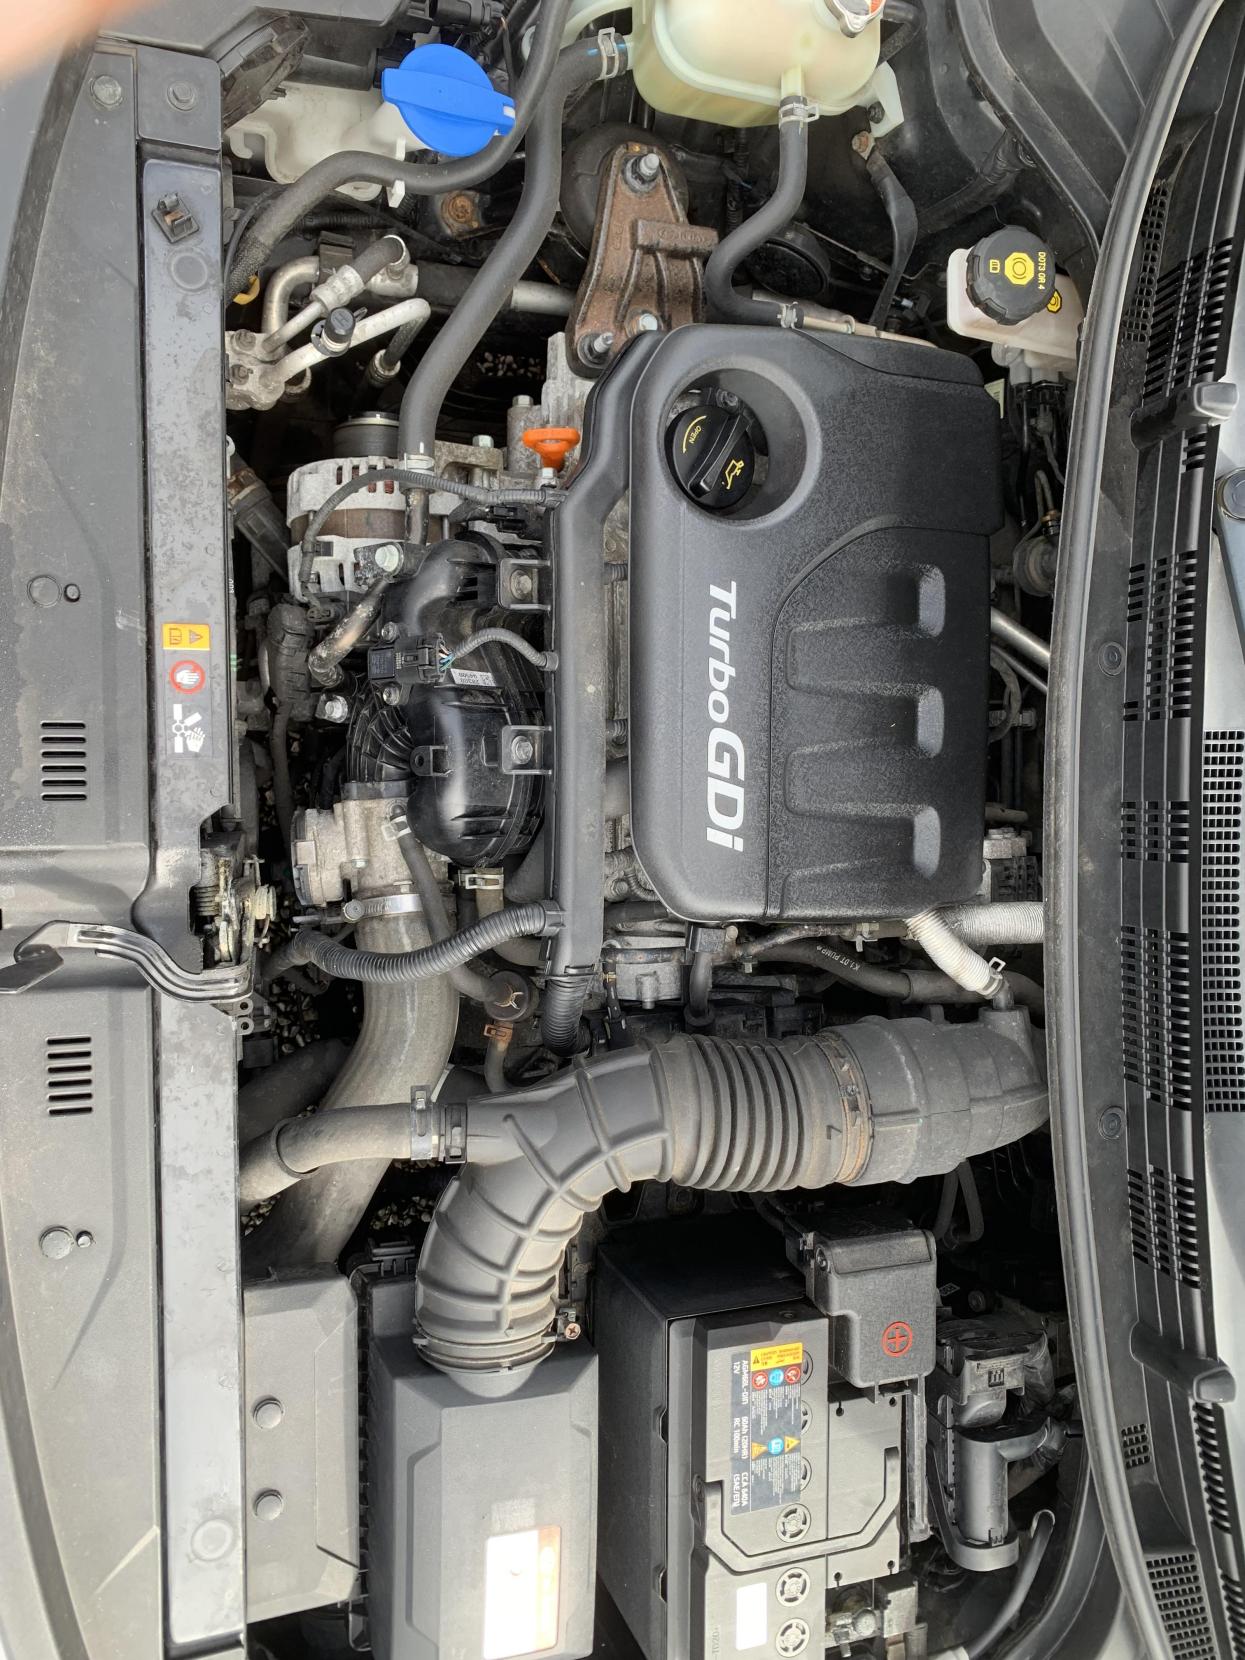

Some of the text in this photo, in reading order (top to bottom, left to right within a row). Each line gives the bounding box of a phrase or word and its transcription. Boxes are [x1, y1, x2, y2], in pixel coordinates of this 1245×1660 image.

[1038, 252, 1046, 271] DOT3
[1038, 272, 1046, 284] OR
[689, 426, 701, 444] OPEN
[821, 948, 840, 961] PUMP
[733, 1361, 741, 1374] 12V
[733, 1417, 741, 1428] RC
[733, 1429, 741, 1454] 100min
[741, 1472, 749, 1486] CCA
